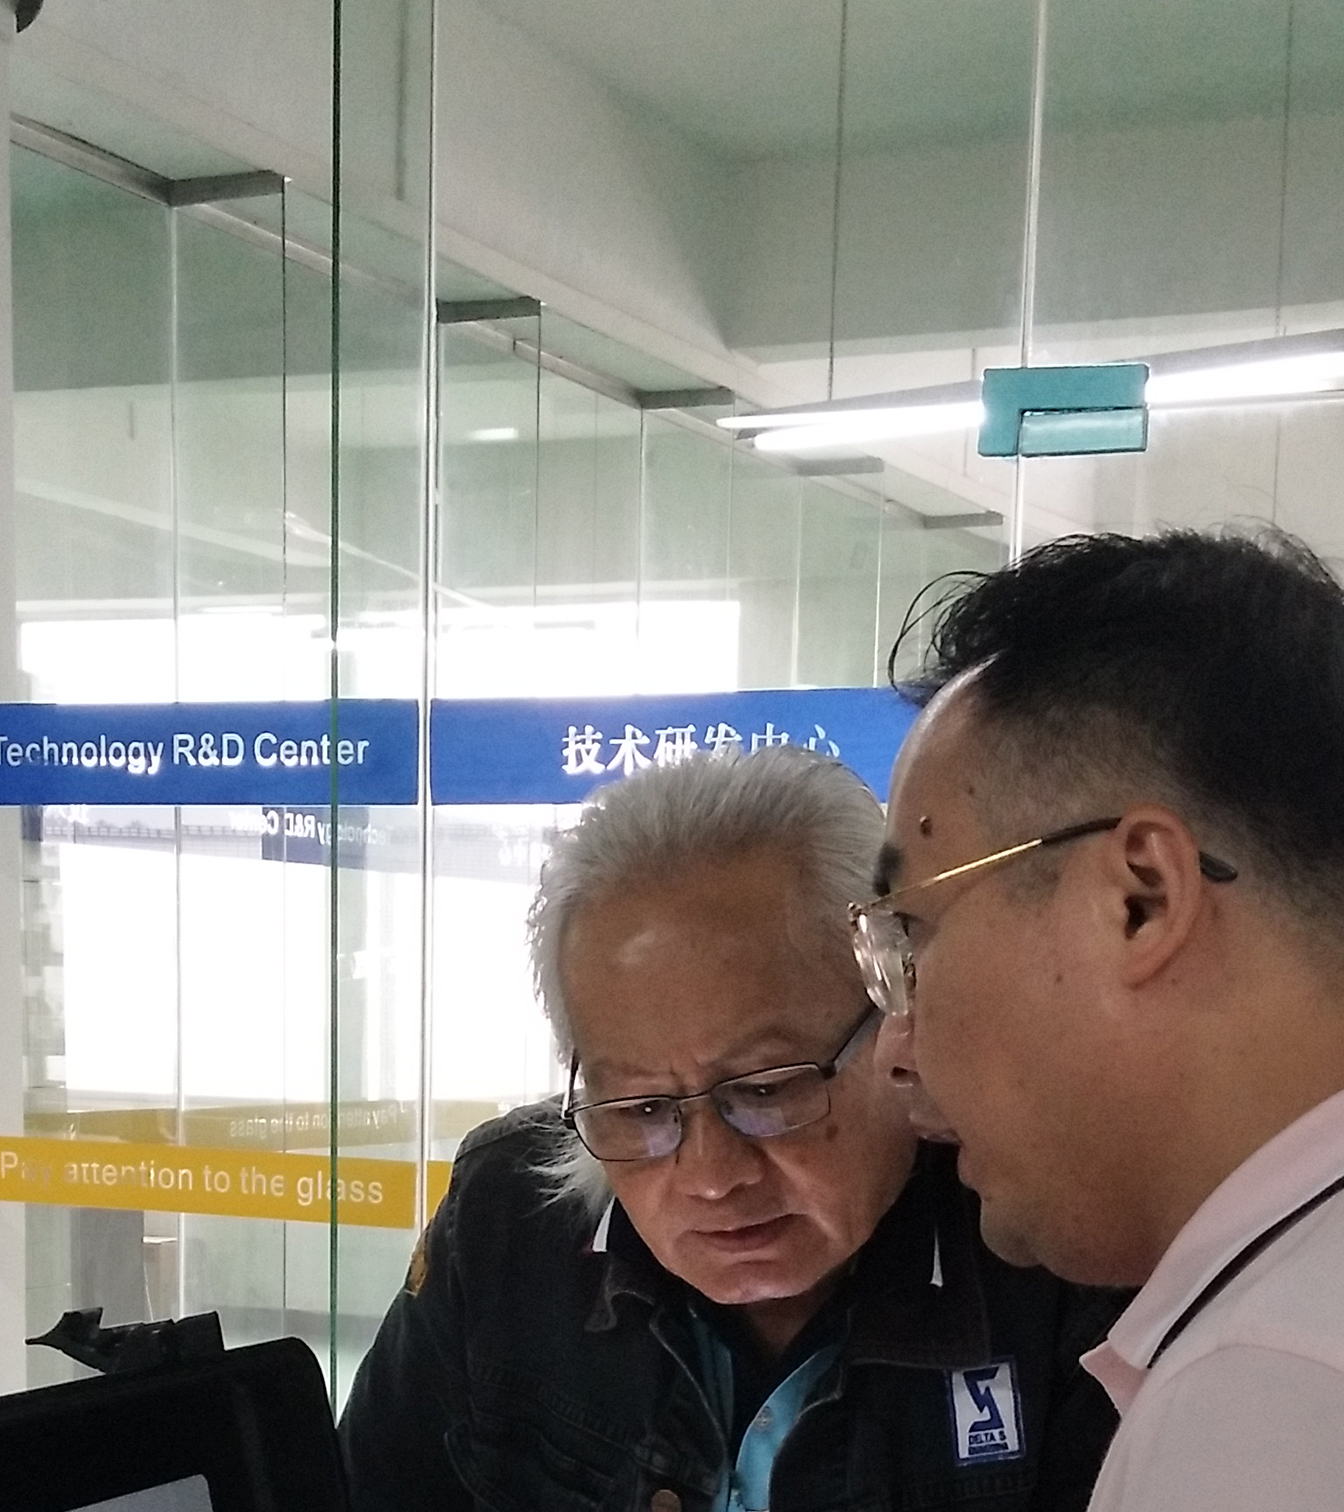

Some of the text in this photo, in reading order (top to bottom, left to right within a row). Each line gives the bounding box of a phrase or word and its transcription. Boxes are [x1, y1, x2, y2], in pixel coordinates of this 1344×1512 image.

[173, 732, 244, 766] R&D
[254, 732, 370, 766] Center
[0, 1151, 384, 1206] Pay attention to the glass
[968, 1432, 996, 1445] DELTA
